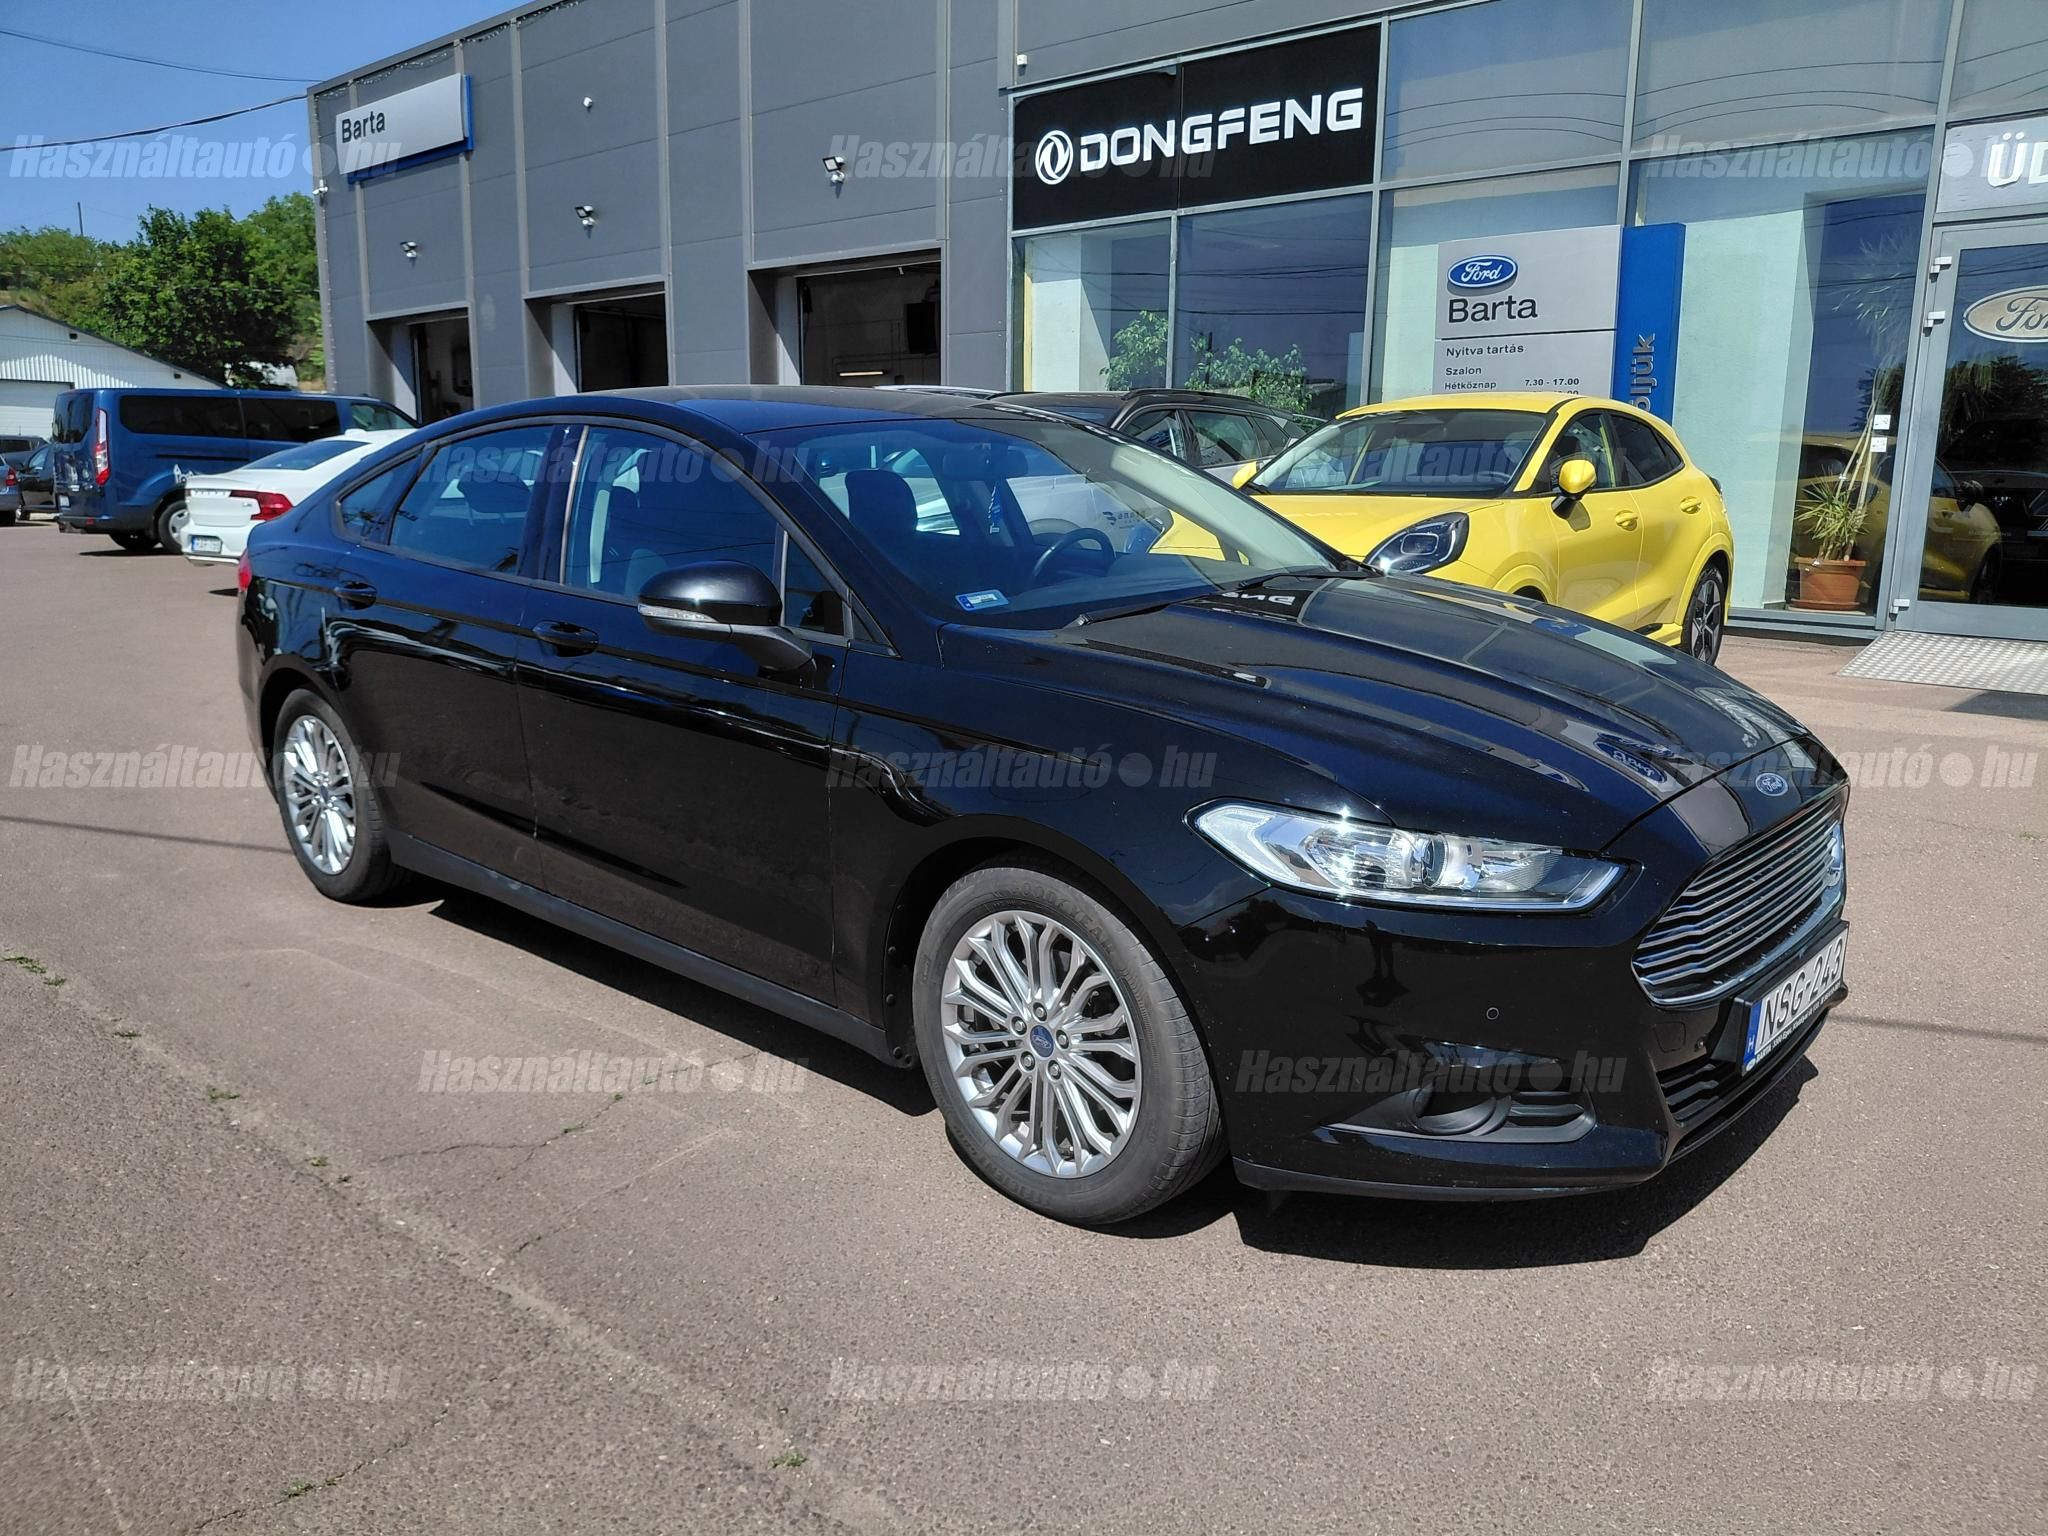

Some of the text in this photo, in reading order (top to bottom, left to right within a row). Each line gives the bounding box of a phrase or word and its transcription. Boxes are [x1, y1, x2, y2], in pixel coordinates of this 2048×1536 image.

[342, 111, 385, 143] Barta
[1080, 87, 1363, 172] DONGFENG
[1460, 261, 1503, 283] Ford
[1448, 295, 1538, 323] Barta
[1446, 344, 1525, 358] Nyitva tartás
[1445, 367, 1482, 376] Szalon
[1444, 381, 1497, 391] Hétköznap
[1525, 379, 1544, 387] 7.30
[1553, 378, 1580, 386] 17.00
[1760, 937, 1843, 1045] NSG-243
[1747, 1035, 1755, 1053] H
